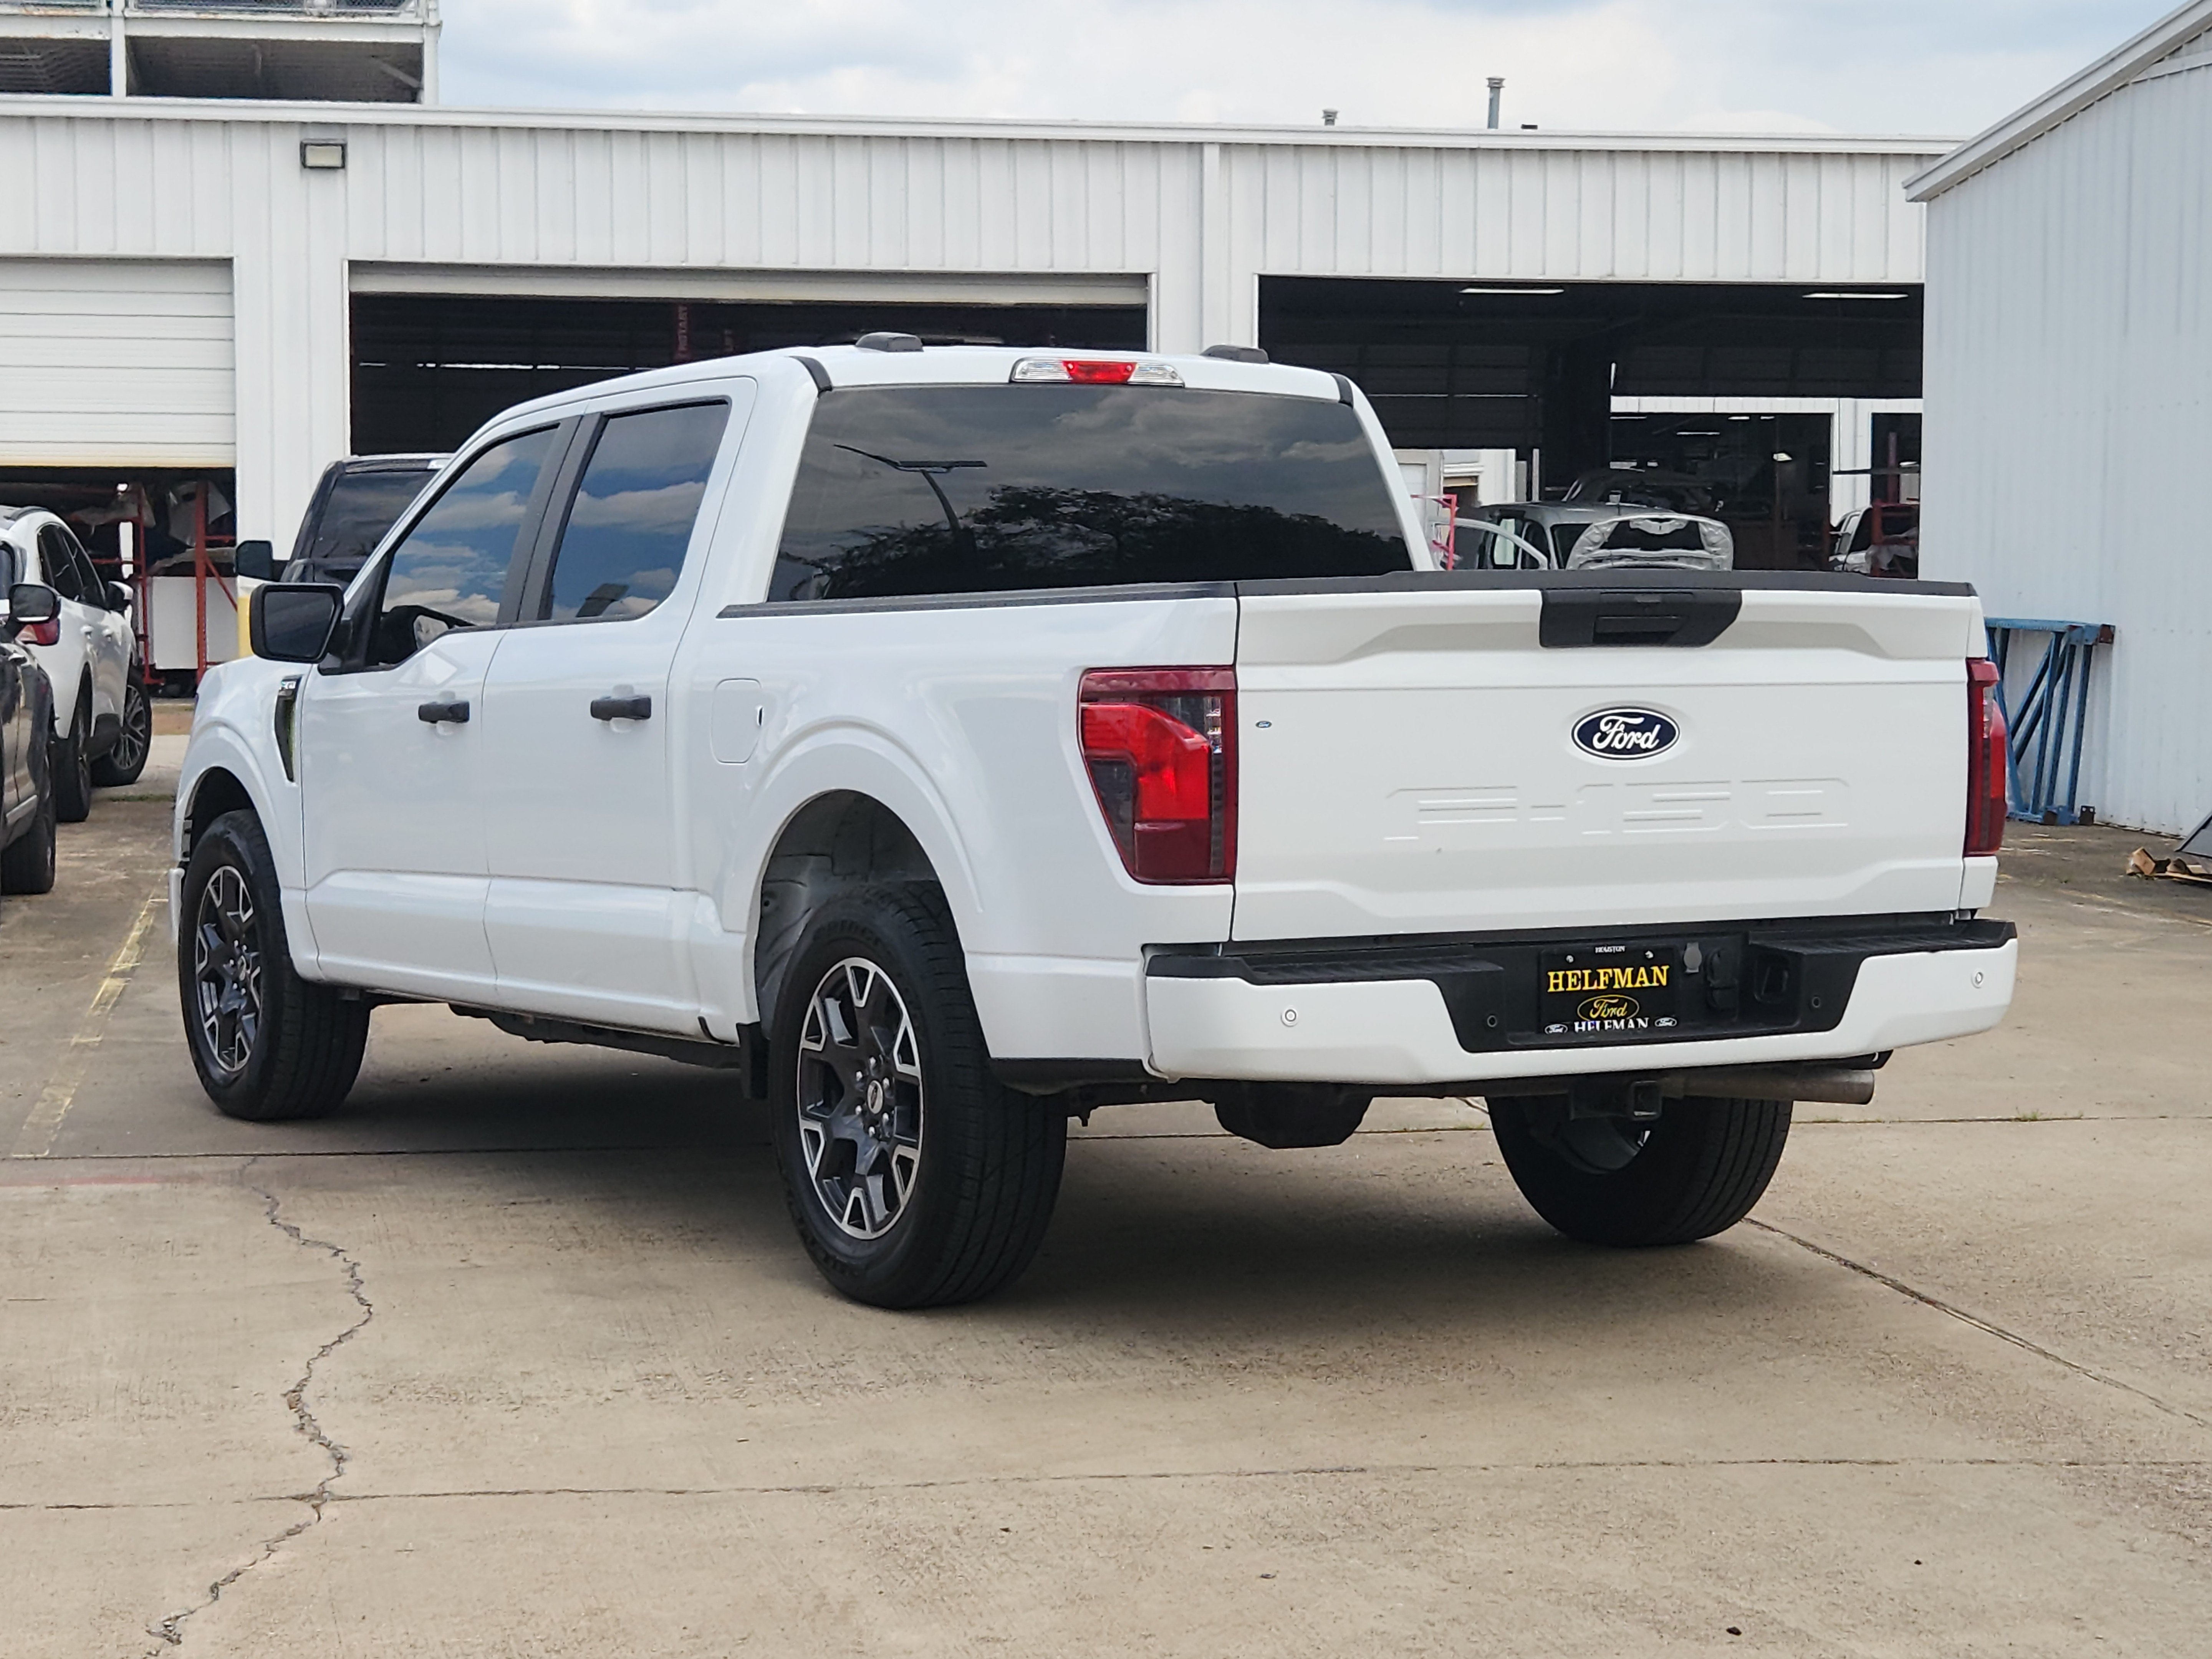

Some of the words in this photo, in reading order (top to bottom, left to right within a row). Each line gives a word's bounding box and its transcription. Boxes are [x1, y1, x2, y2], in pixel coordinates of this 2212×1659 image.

[1593, 715, 1661, 749] Ford
[1547, 965, 1669, 992] HELFMAN
[1590, 998, 1628, 1018] Ford
